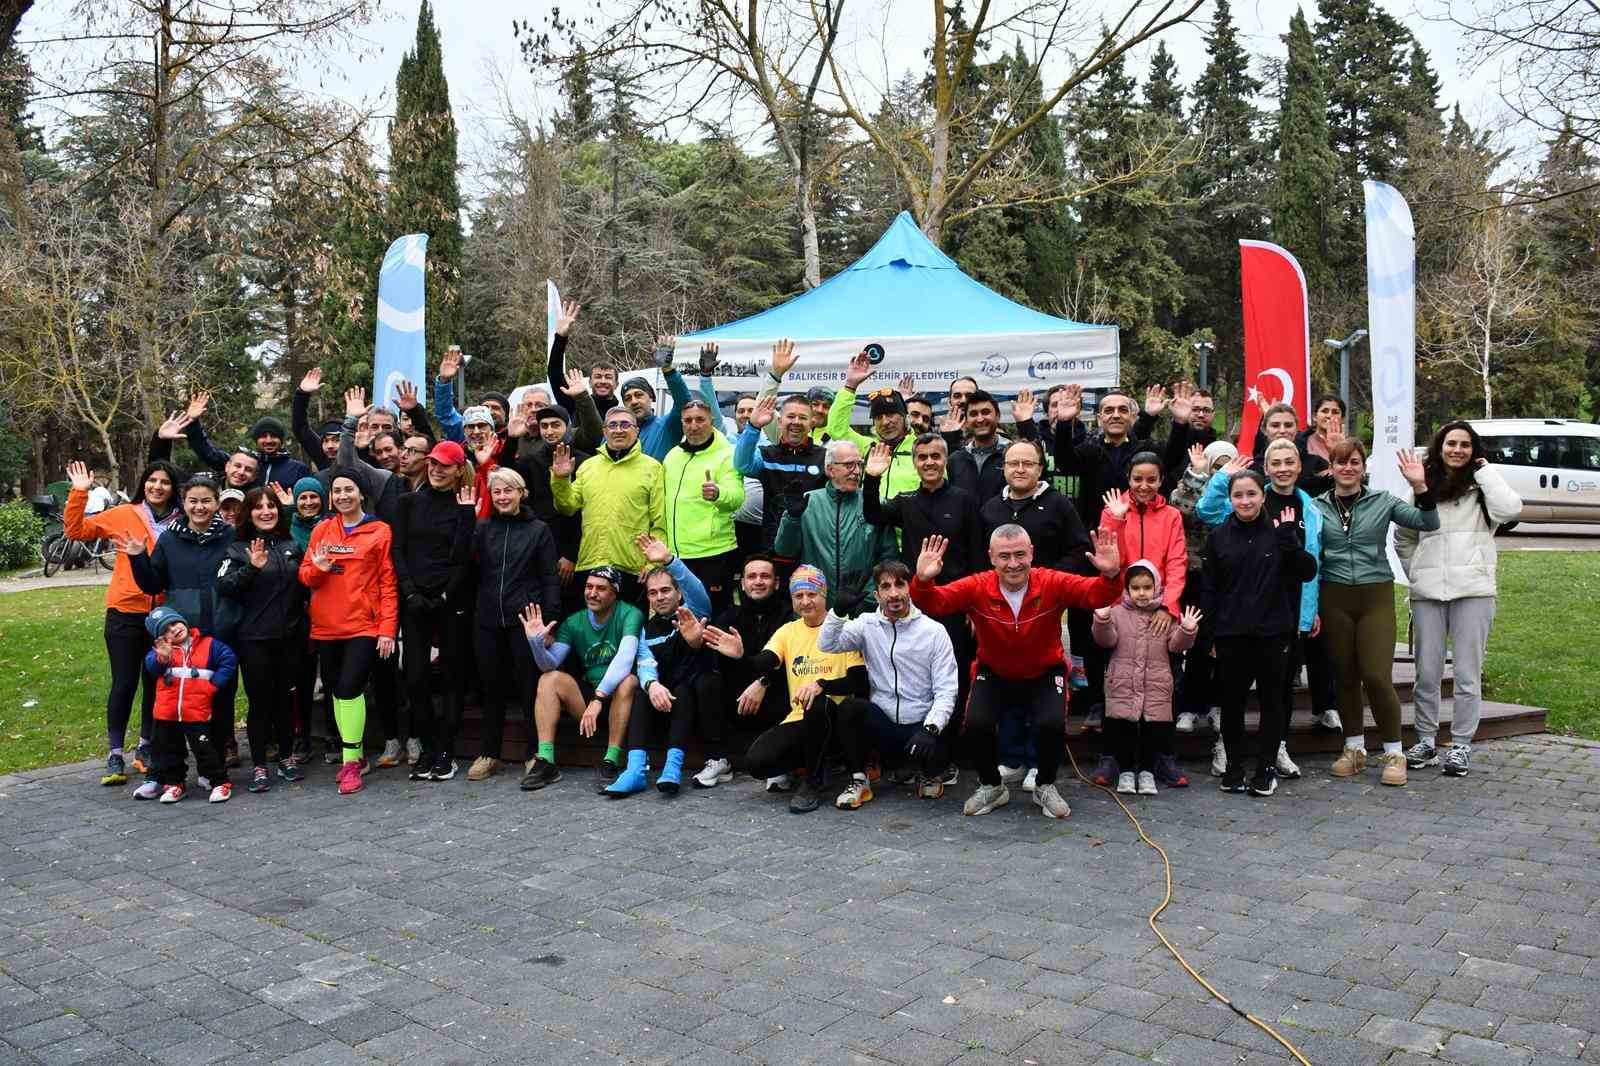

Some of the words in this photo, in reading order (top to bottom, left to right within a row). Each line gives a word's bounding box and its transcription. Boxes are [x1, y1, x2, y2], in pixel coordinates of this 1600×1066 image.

[1037, 360, 1058, 371] 444
[1062, 359, 1076, 370] 40
[1082, 359, 1094, 370] 10
